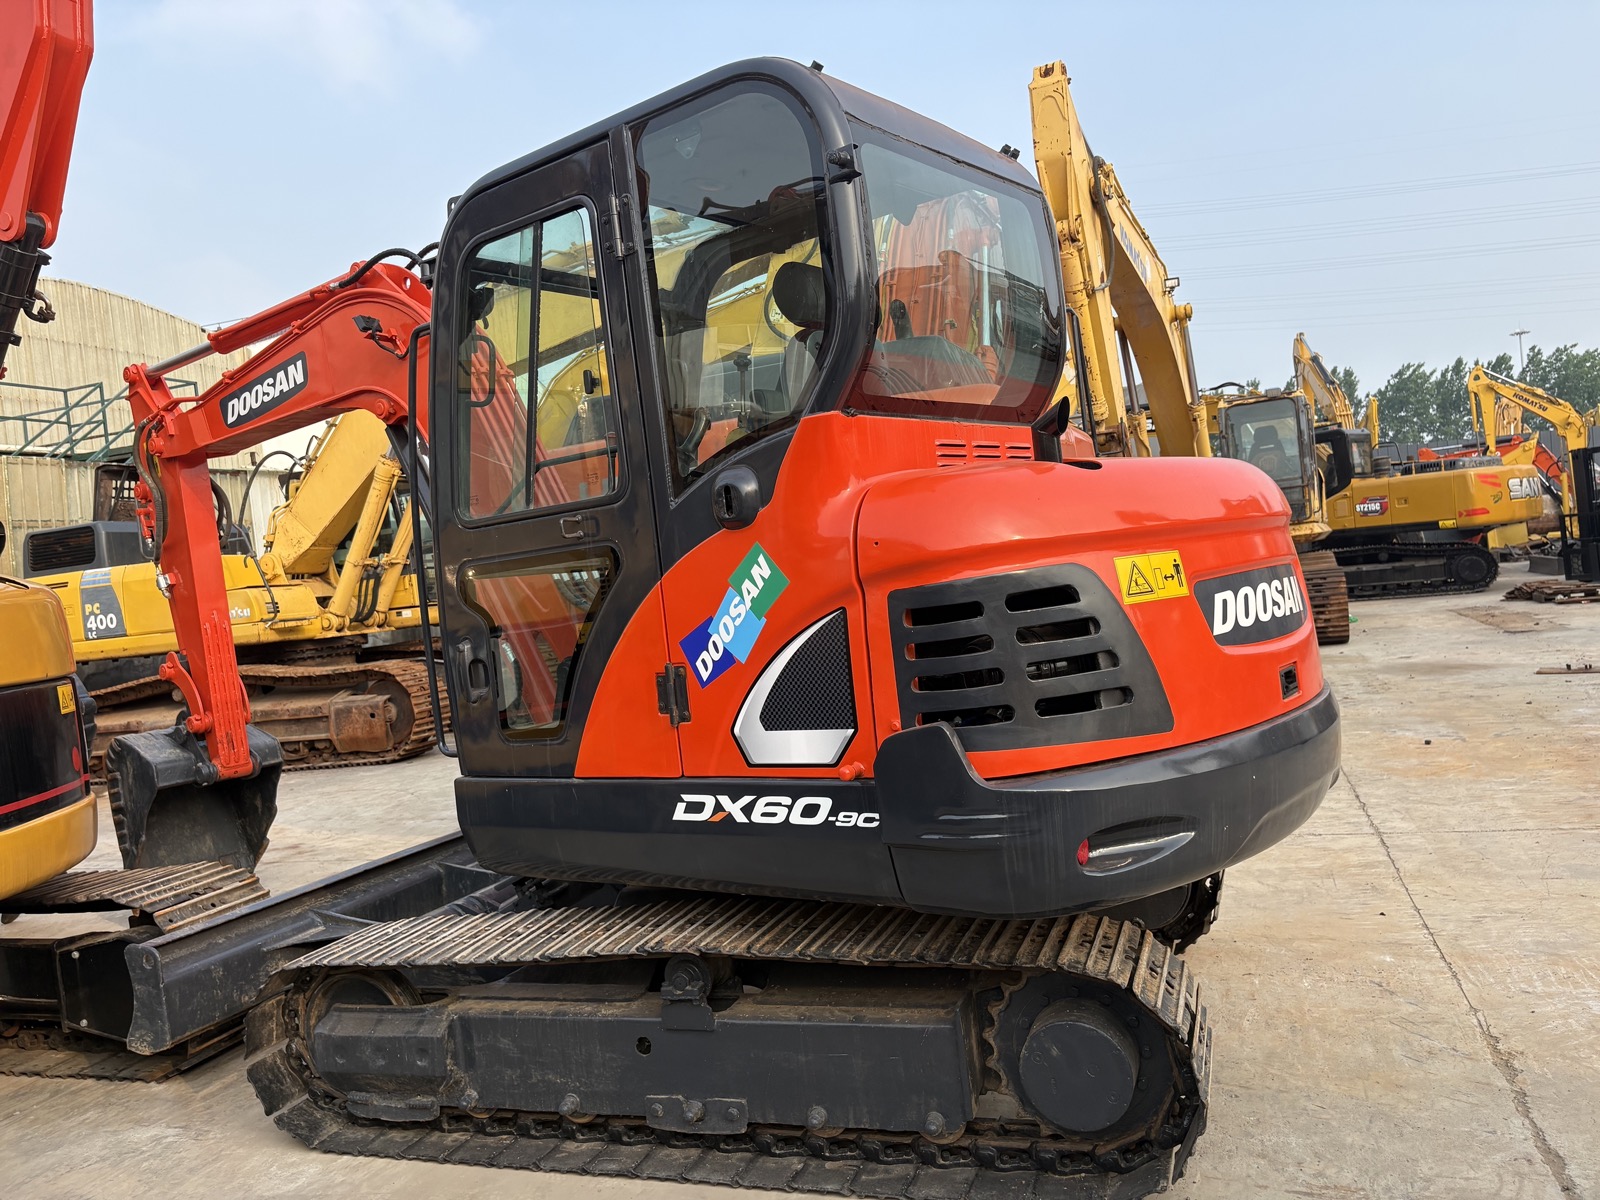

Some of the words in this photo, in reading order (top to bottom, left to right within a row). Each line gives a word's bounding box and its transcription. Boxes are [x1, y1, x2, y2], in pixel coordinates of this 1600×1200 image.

[227, 359, 304, 425] DOOSAN
[1512, 392, 1548, 412] KOMATSU
[85, 603, 101, 616] PC
[695, 553, 772, 682] DOOSAN
[1213, 576, 1304, 636] DOOSAN
[87, 613, 117, 630] 400
[88, 631, 98, 639] LC
[672, 794, 880, 828] DX60-9C
